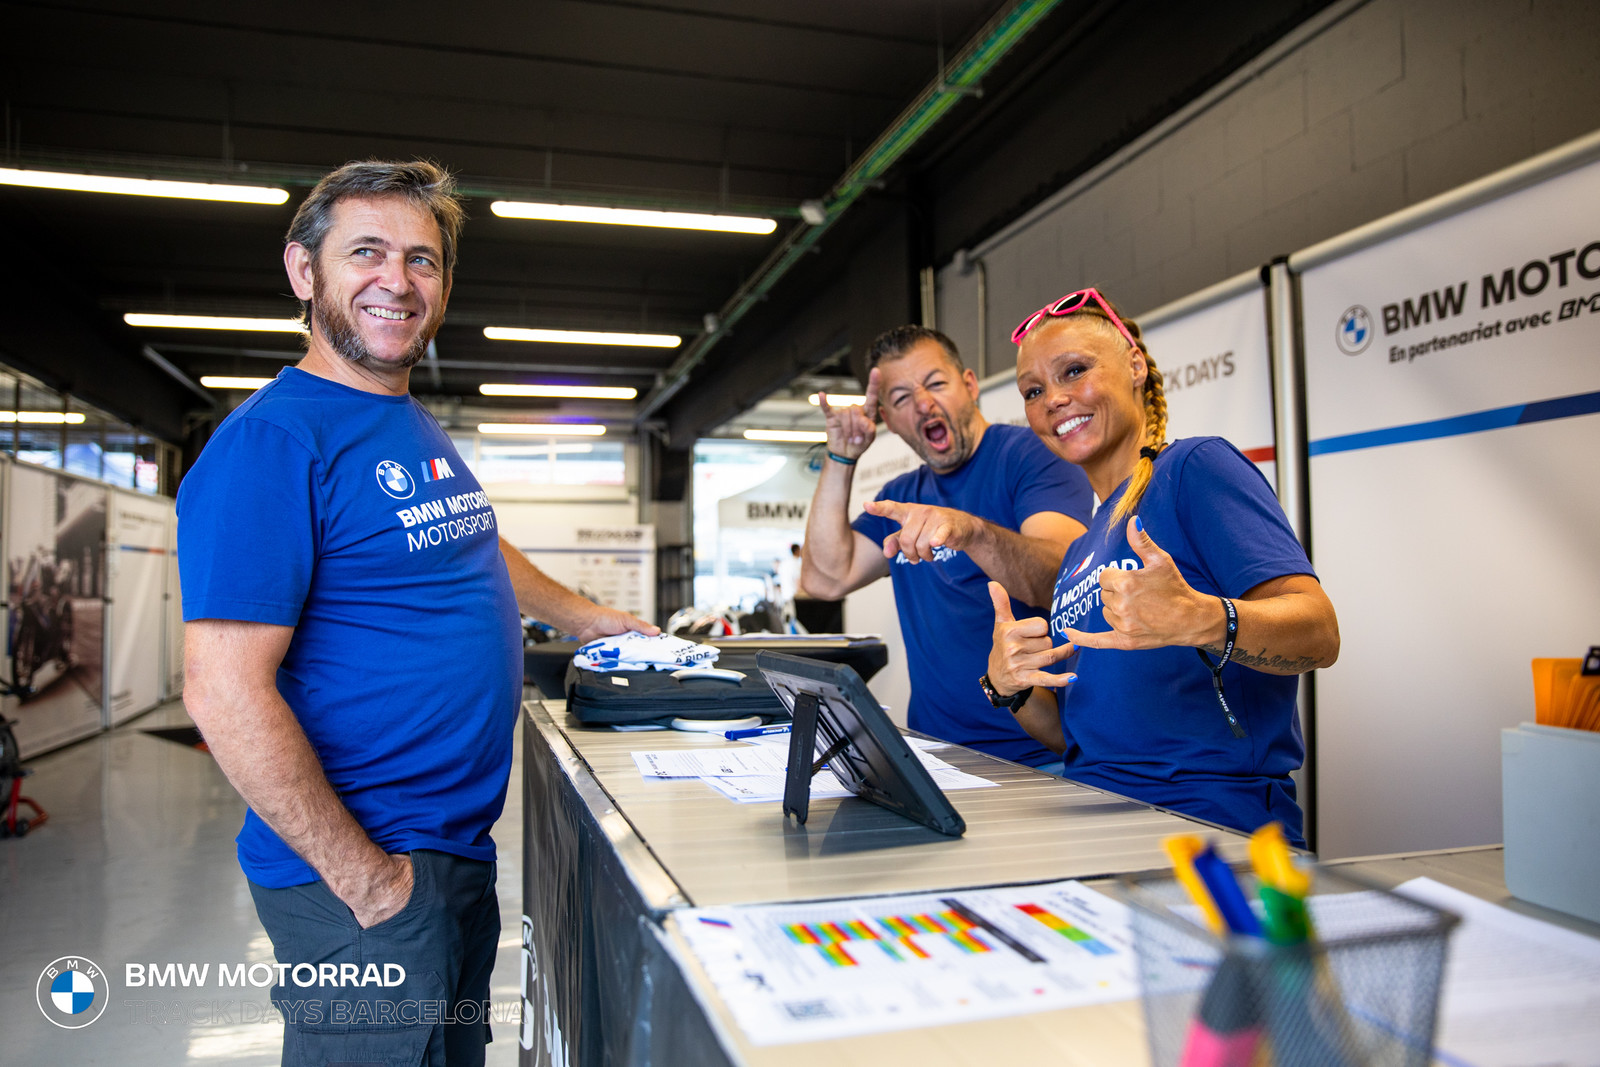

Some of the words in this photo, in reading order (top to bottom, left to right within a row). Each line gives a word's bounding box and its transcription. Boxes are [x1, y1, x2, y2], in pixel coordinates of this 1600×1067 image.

[1382, 281, 1468, 336] BMW
[1389, 347, 1405, 364] En
[1408, 321, 1502, 364] partenariat
[1506, 310, 1551, 334] avec
[1185, 350, 1235, 387] DAYS
[396, 499, 447, 528] BMW
[445, 490, 490, 515] MOTORR
[747, 501, 806, 521] BMW
[406, 511, 495, 553] MOTORSPORT
[1050, 587, 1102, 637] TORSPORT
[1218, 641, 1233, 669] ORRAD
